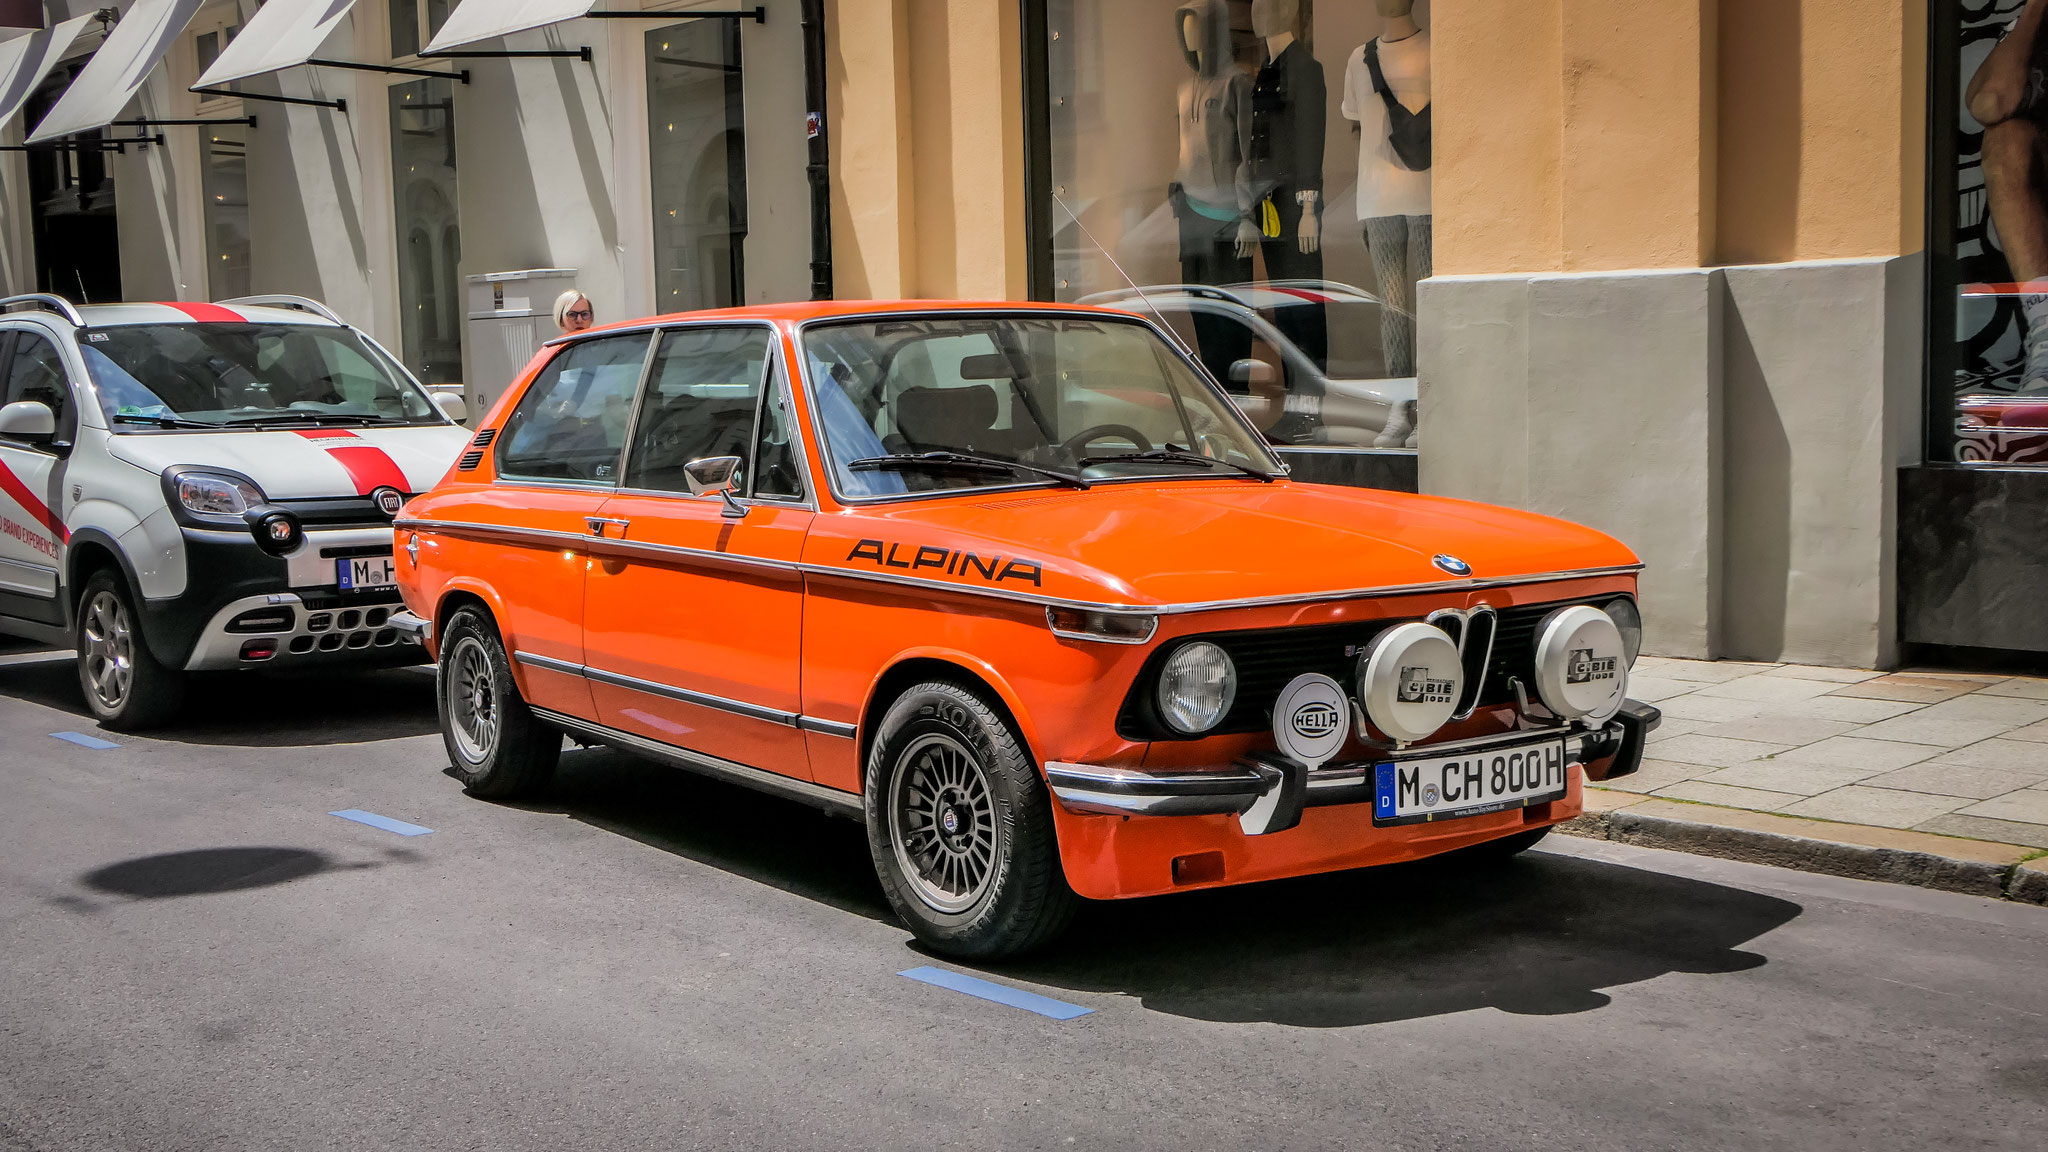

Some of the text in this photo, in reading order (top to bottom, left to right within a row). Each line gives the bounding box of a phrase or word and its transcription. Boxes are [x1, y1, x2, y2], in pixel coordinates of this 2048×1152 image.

[875, 319, 1106, 338] ALPINA
[384, 496, 399, 509] FIAT
[3, 517, 22, 541] BRAND
[22, 527, 60, 560] EXPERIENCES
[342, 576, 349, 584] D
[354, 560, 369, 584] M
[846, 538, 1042, 587] ALPINA
[1296, 712, 1338, 727] HELLA
[1382, 745, 1562, 808] D M CH 800H
